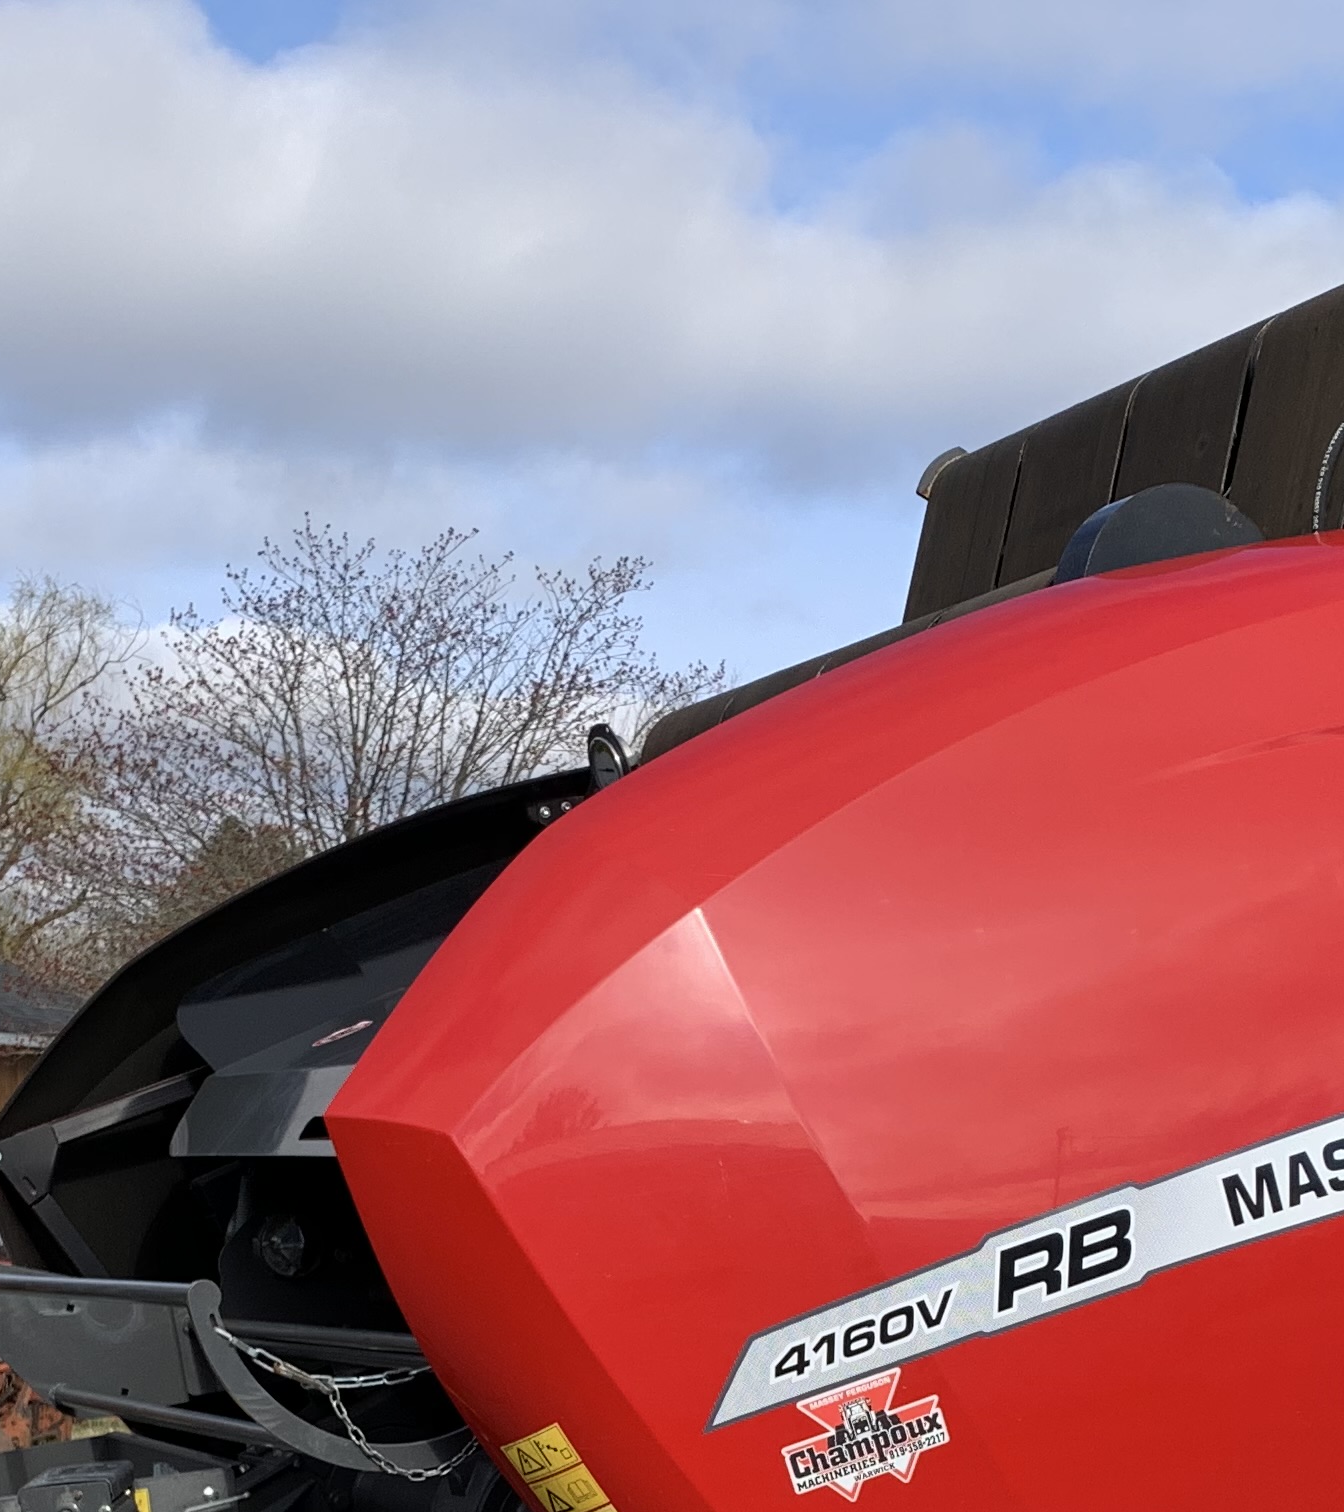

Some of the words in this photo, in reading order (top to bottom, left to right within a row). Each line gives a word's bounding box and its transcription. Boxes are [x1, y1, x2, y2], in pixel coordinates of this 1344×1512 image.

[774, 1289, 953, 1378] 4160V
[997, 1208, 1132, 1313] RB
[809, 1392, 844, 1410] MASSEY
[846, 1376, 891, 1397] FERGUSON
[789, 1412, 943, 1479] Champoux
[889, 1431, 946, 1461] 819-358-2217
[797, 1457, 877, 1492] MACHINERIES
[853, 1462, 896, 1483] WARWICK
